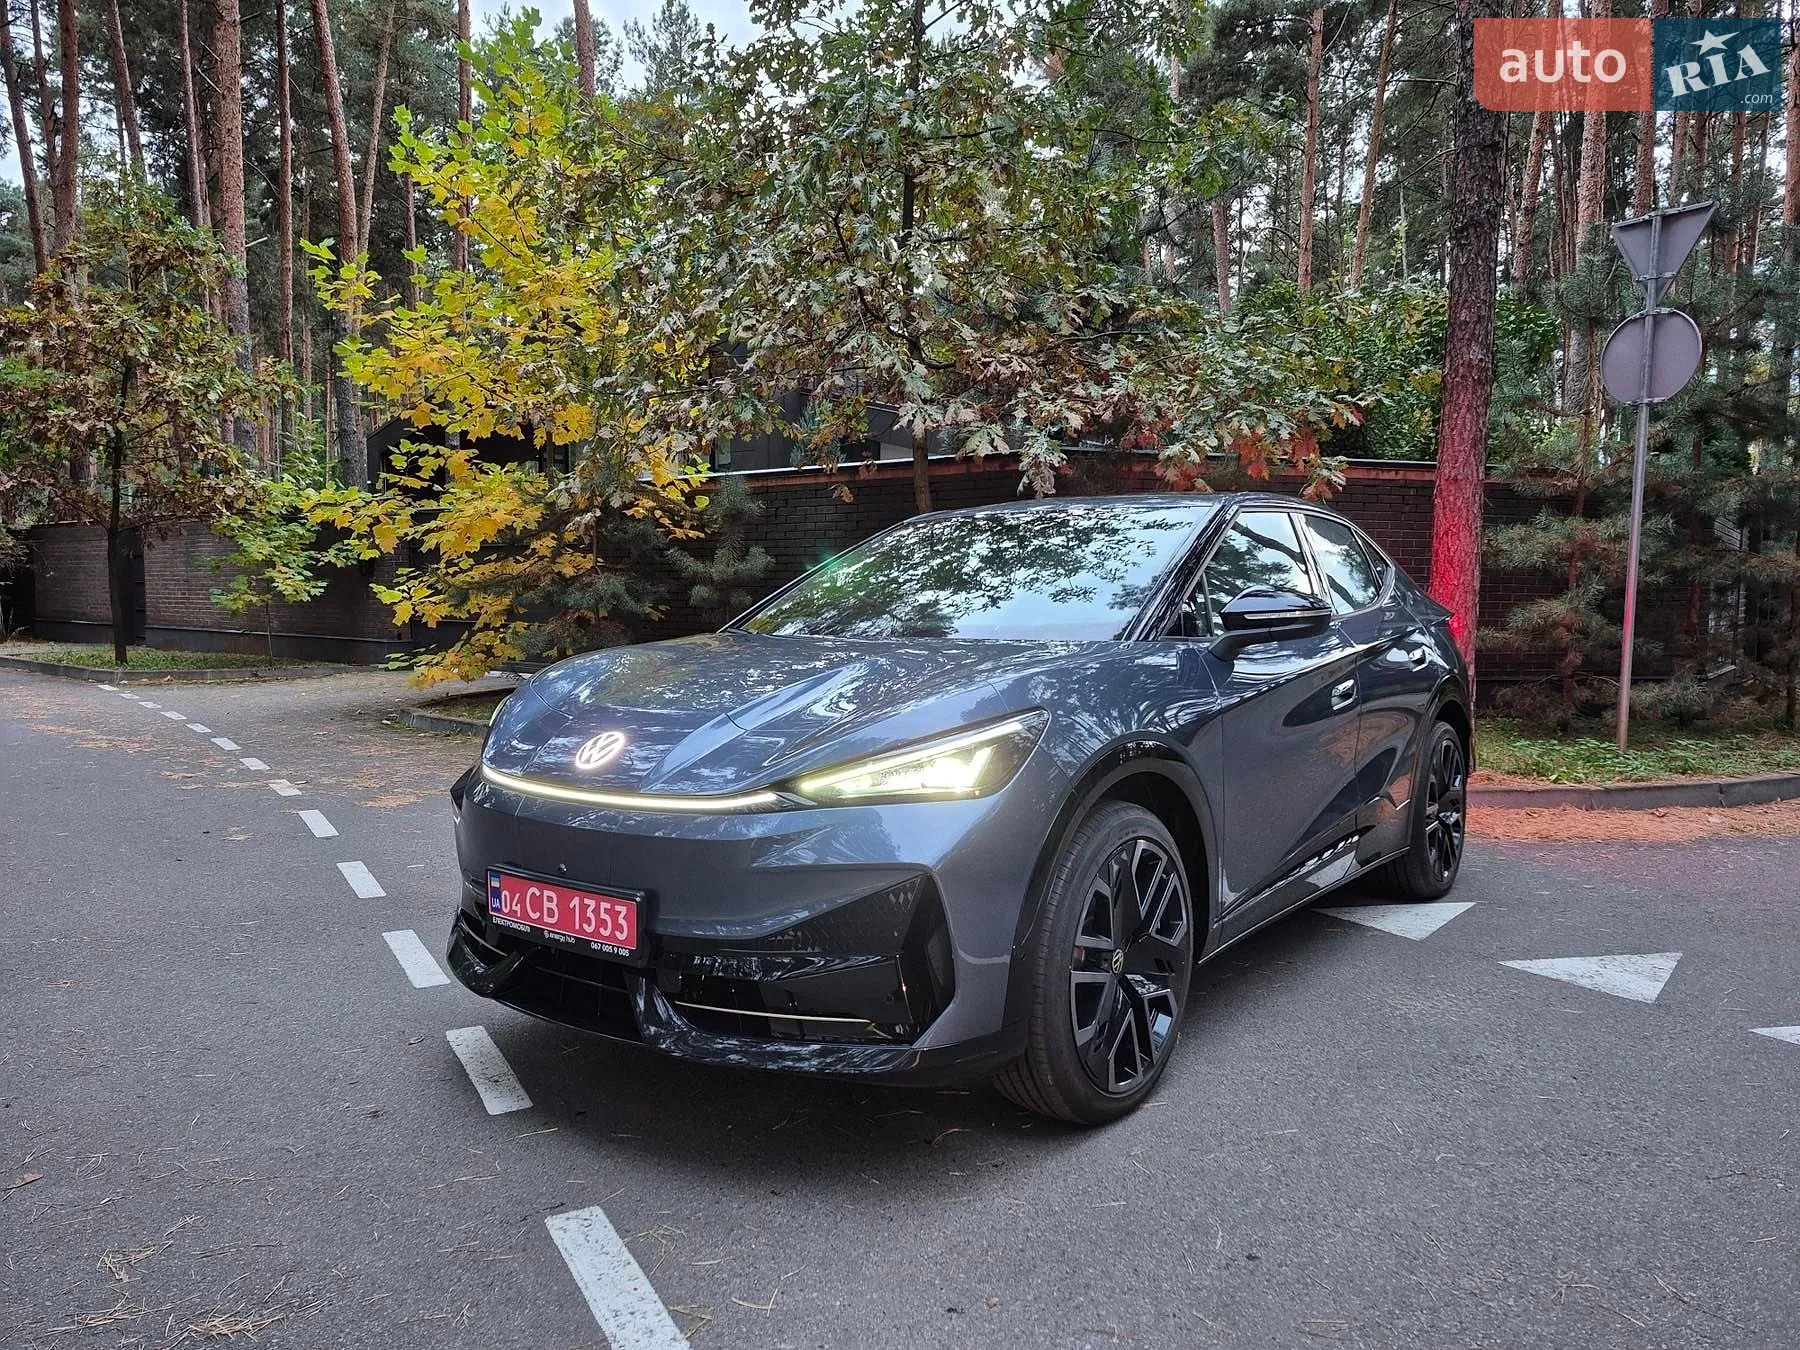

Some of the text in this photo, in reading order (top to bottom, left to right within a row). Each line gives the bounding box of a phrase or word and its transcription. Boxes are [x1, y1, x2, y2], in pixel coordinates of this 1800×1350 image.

[491, 897, 500, 908] UA
[569, 896, 628, 940] 1353
[549, 932, 576, 944] energy hub
[590, 941, 601, 951] 067
[613, 946, 618, 954] 9
